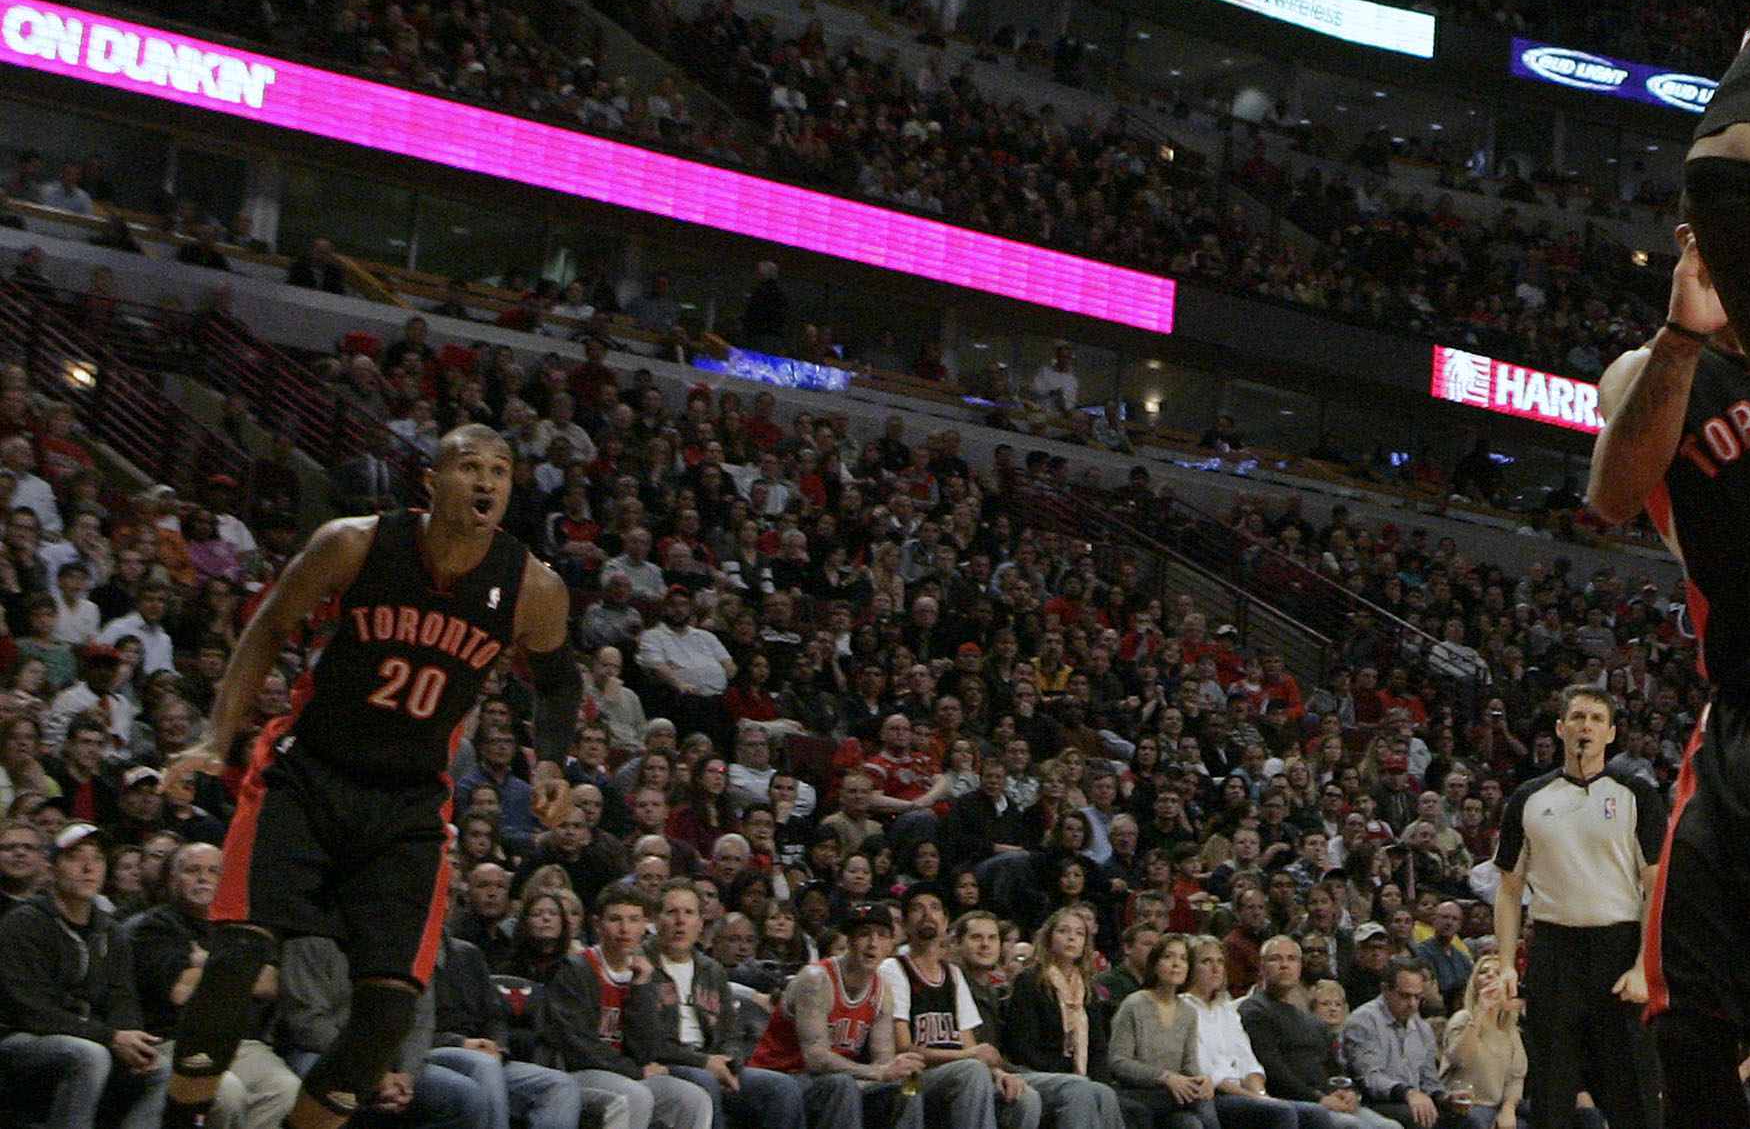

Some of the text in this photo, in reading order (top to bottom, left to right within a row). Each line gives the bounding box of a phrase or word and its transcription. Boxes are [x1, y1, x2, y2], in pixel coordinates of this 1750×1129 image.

[1, 4, 84, 66] ON
[1495, 363, 1607, 428] HARR
[351, 604, 501, 670] TORONTO
[368, 656, 448, 720] 20
